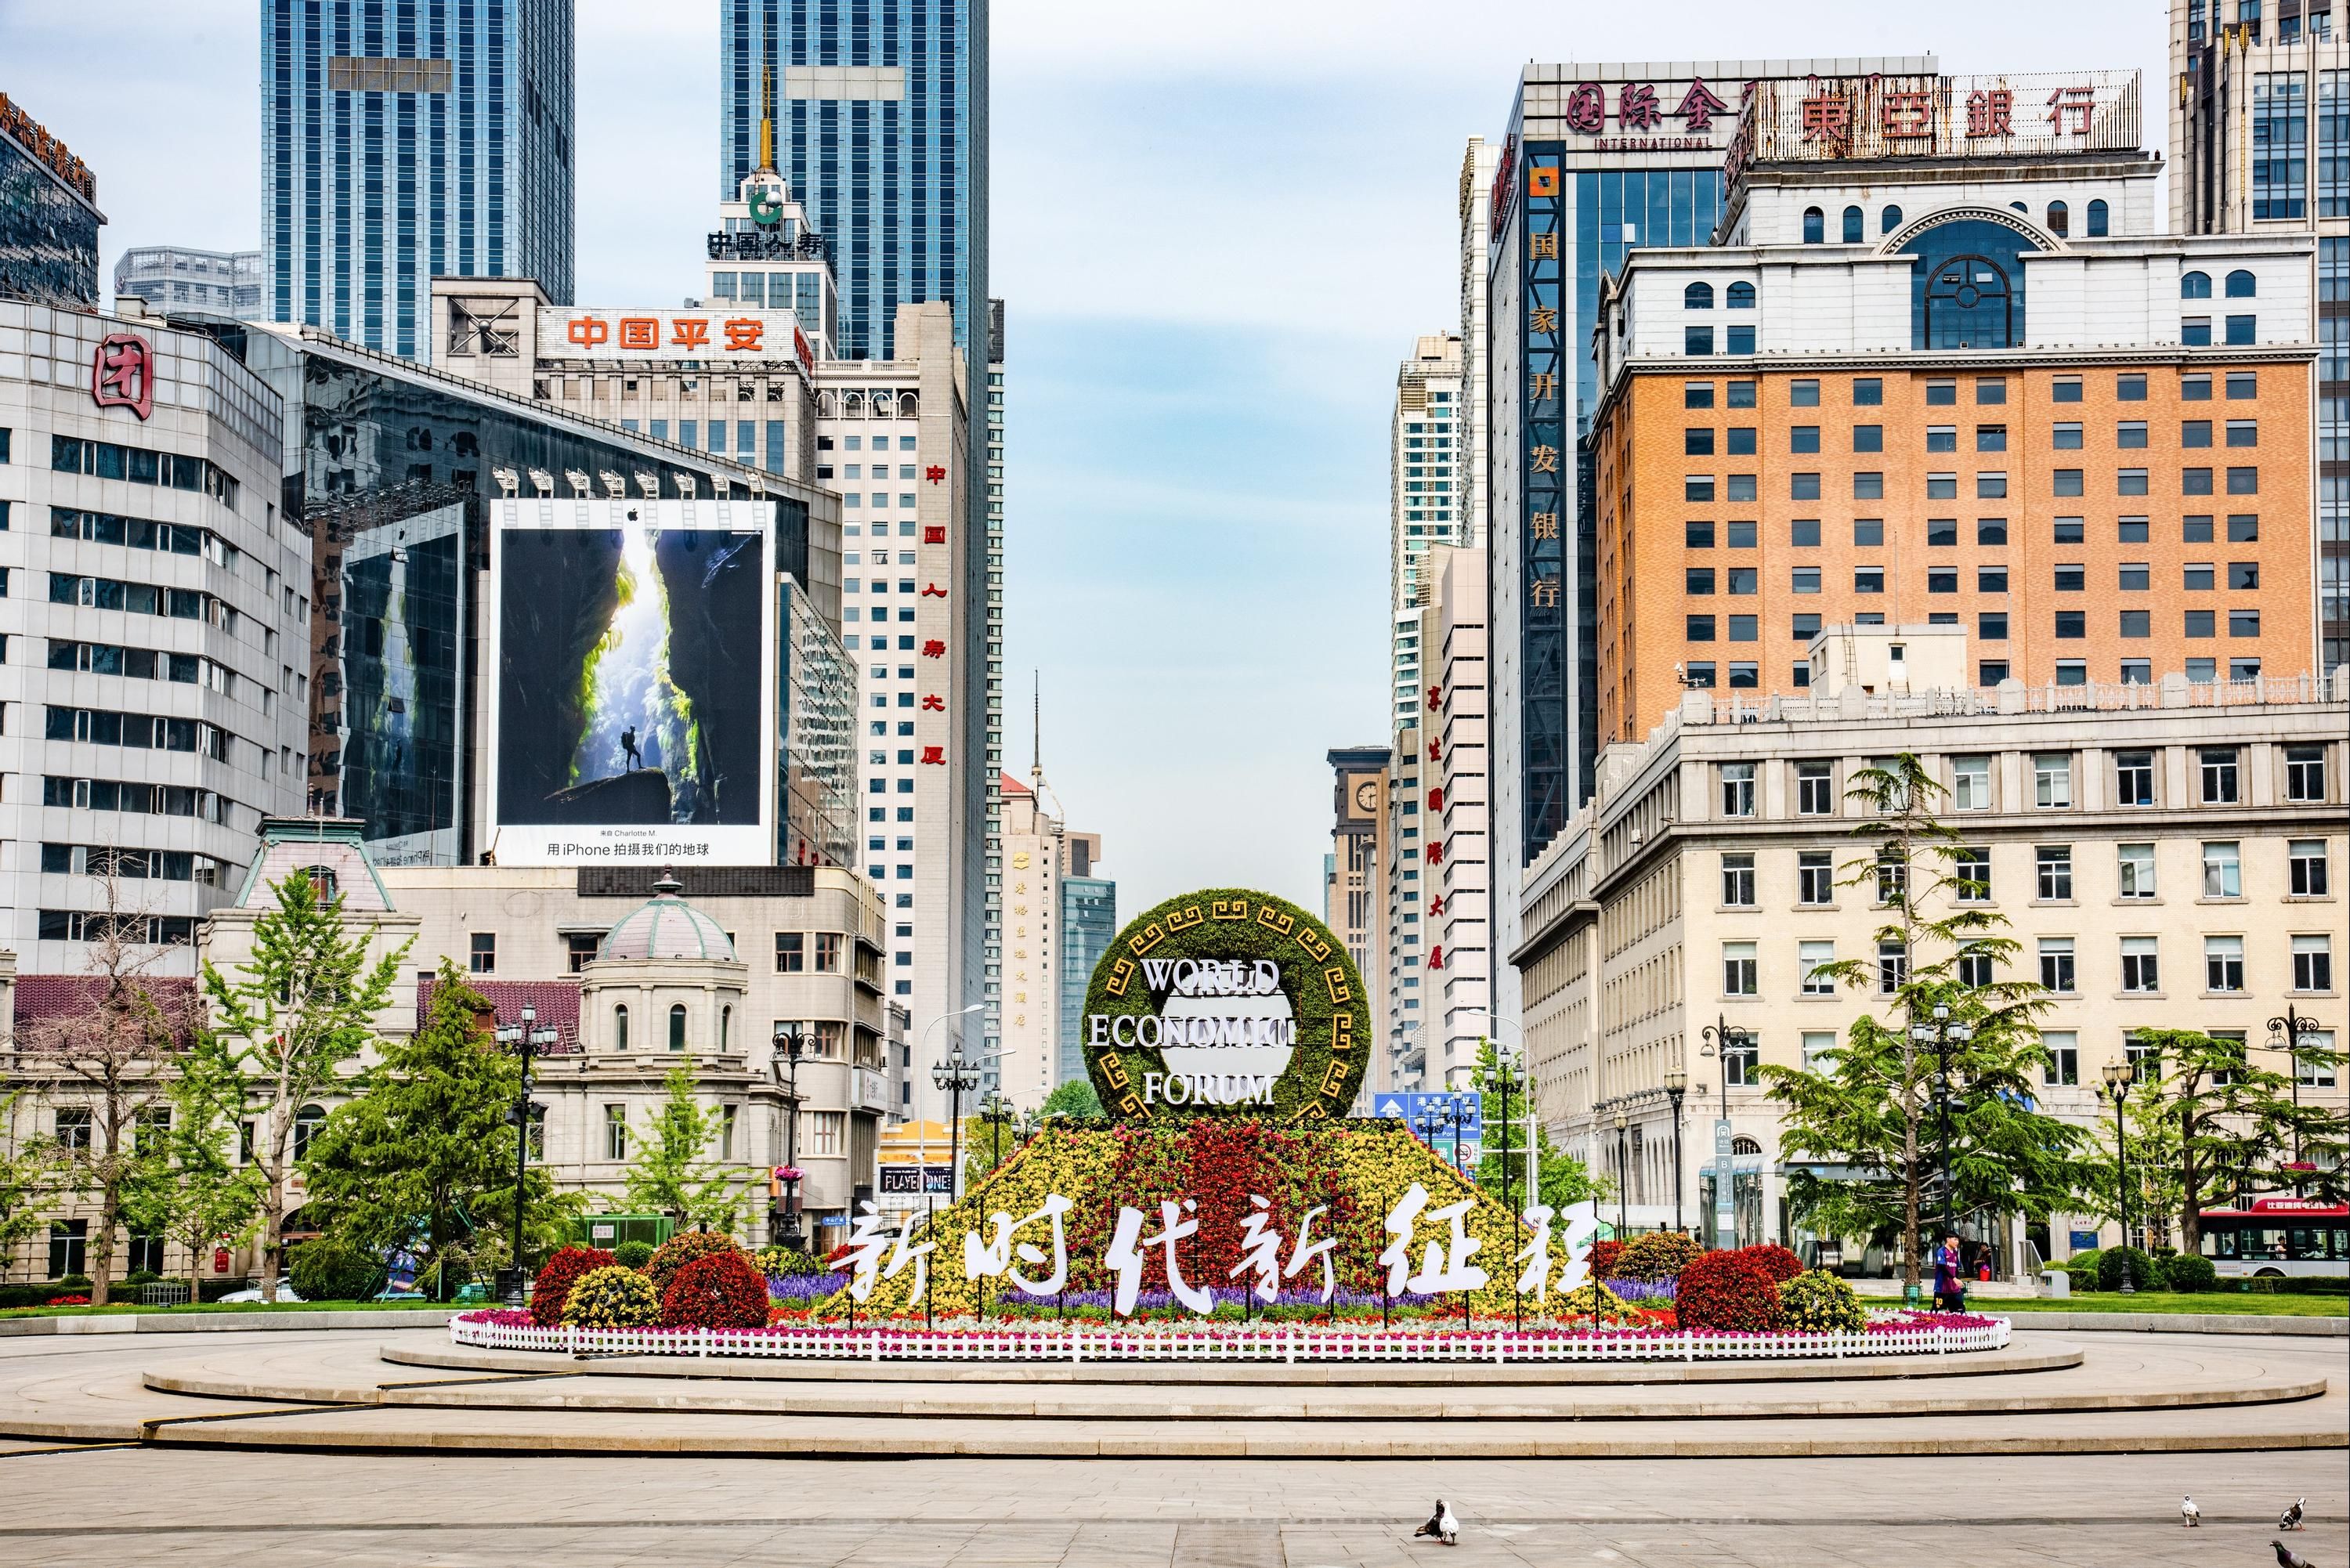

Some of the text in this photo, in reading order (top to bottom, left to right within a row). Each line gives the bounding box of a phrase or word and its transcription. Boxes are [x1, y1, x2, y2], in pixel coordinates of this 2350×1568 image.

[1567, 76, 1756, 132] 国际金
[1802, 87, 2096, 142] 東亞銀行
[1594, 137, 1712, 150] INTERNATIONAL
[707, 230, 822, 254] 中国人寿
[568, 316, 763, 351] 中国平安
[1530, 232, 1559, 608] 国家开发银行
[920, 465, 947, 765] 中国人寿大厦
[547, 843, 710, 856] 用 iPhone 拍摄我们的地球
[1140, 959, 1279, 992] WORLD
[1087, 1014, 1289, 1048] ECONOMIC
[1143, 1071, 1275, 1105] FORUM
[927, 1175, 948, 1190] ONE
[830, 1182, 1599, 1316] 新时代新征程
